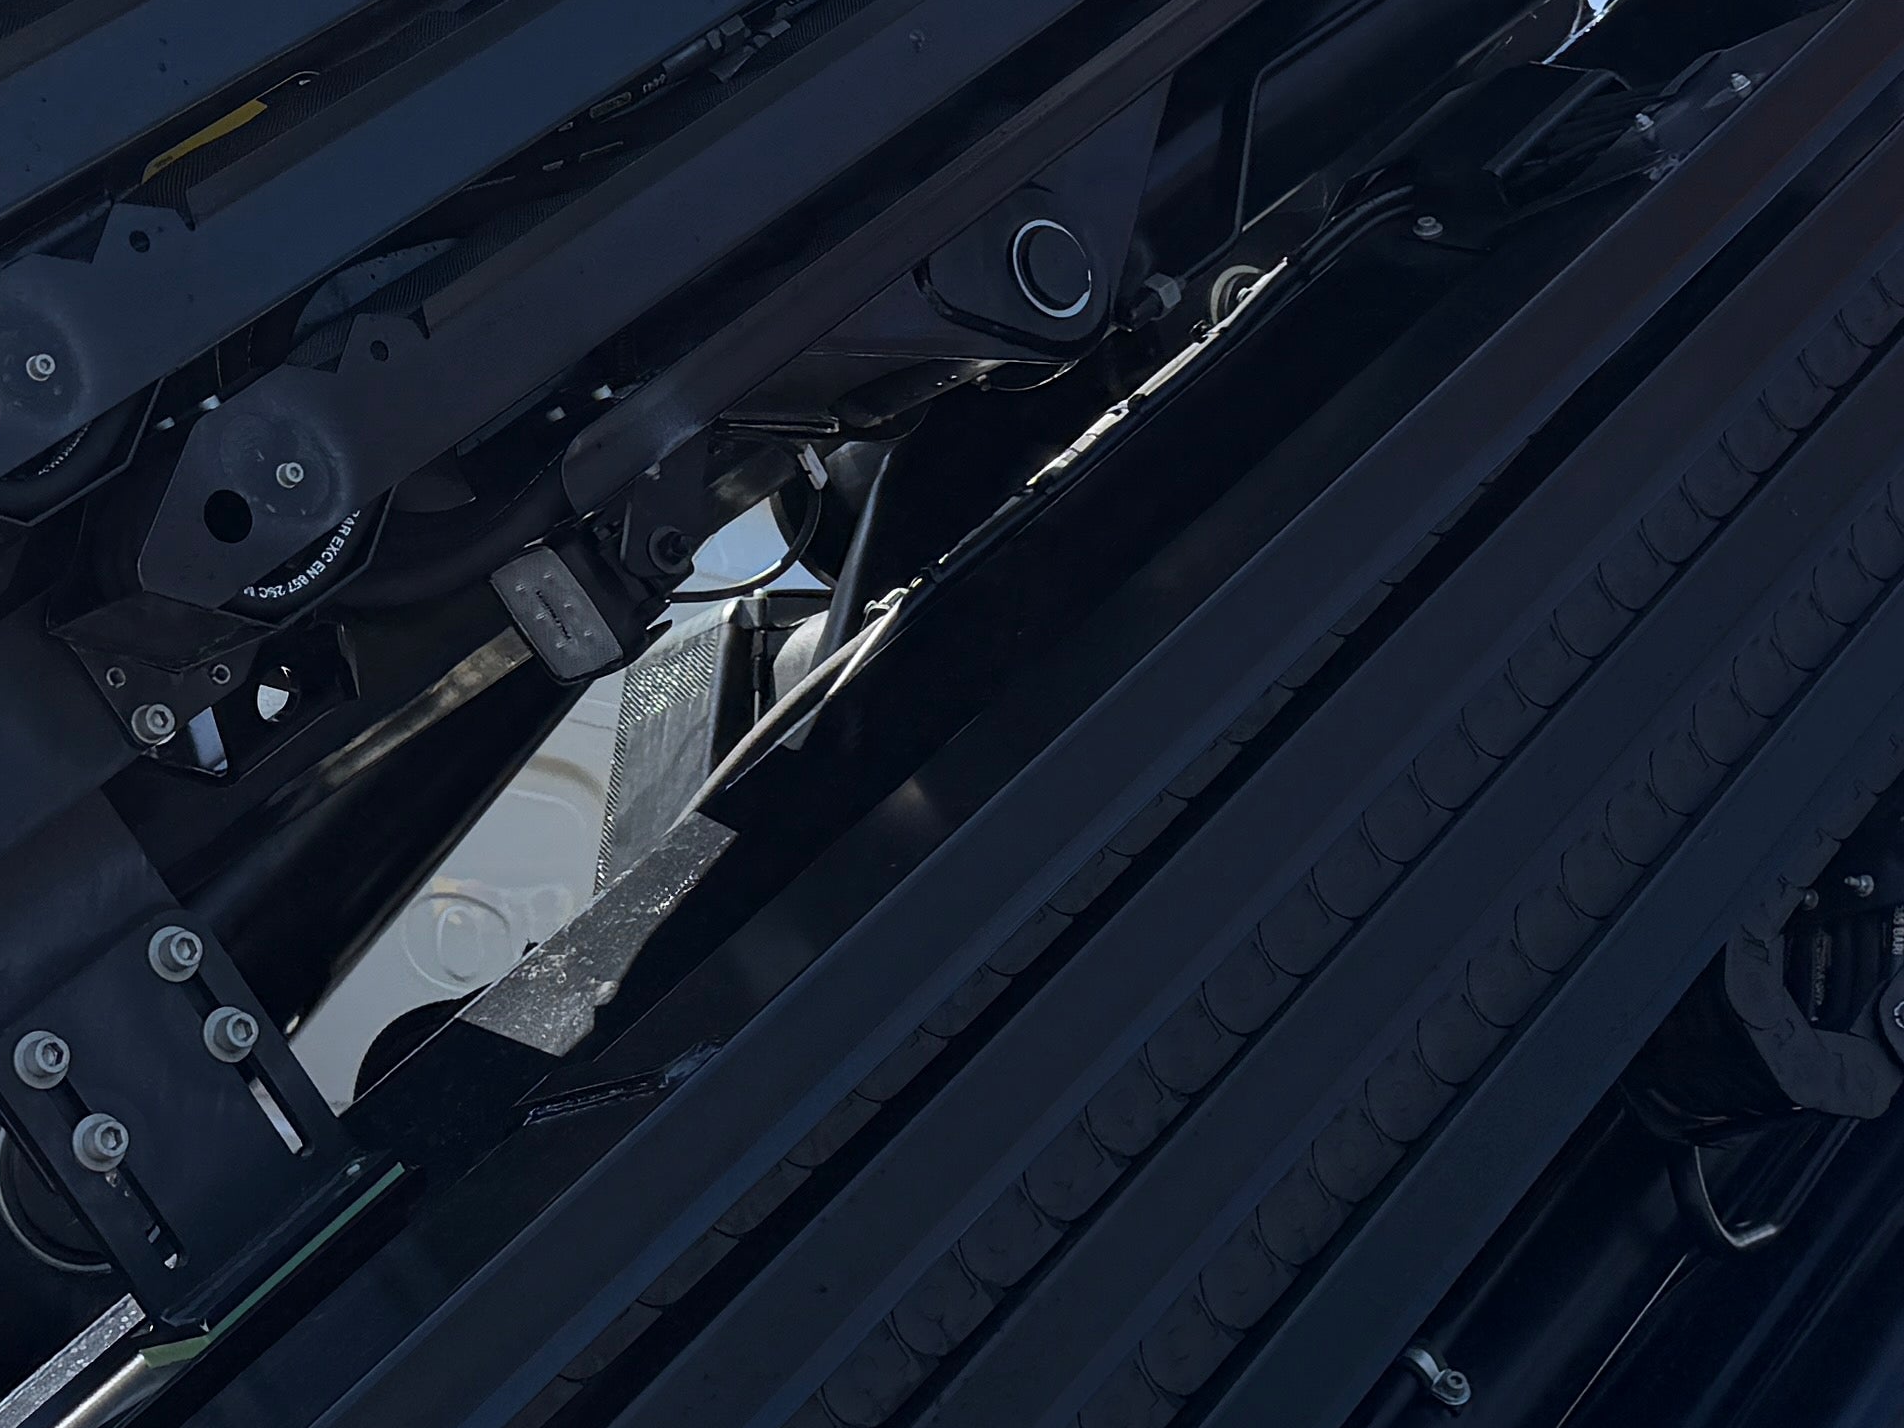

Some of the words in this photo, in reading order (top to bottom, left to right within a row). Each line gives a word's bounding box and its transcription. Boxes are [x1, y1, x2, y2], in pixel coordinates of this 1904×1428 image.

[320, 536, 346, 564] EXC
[305, 560, 328, 581] EN
[287, 574, 311, 594] 857
